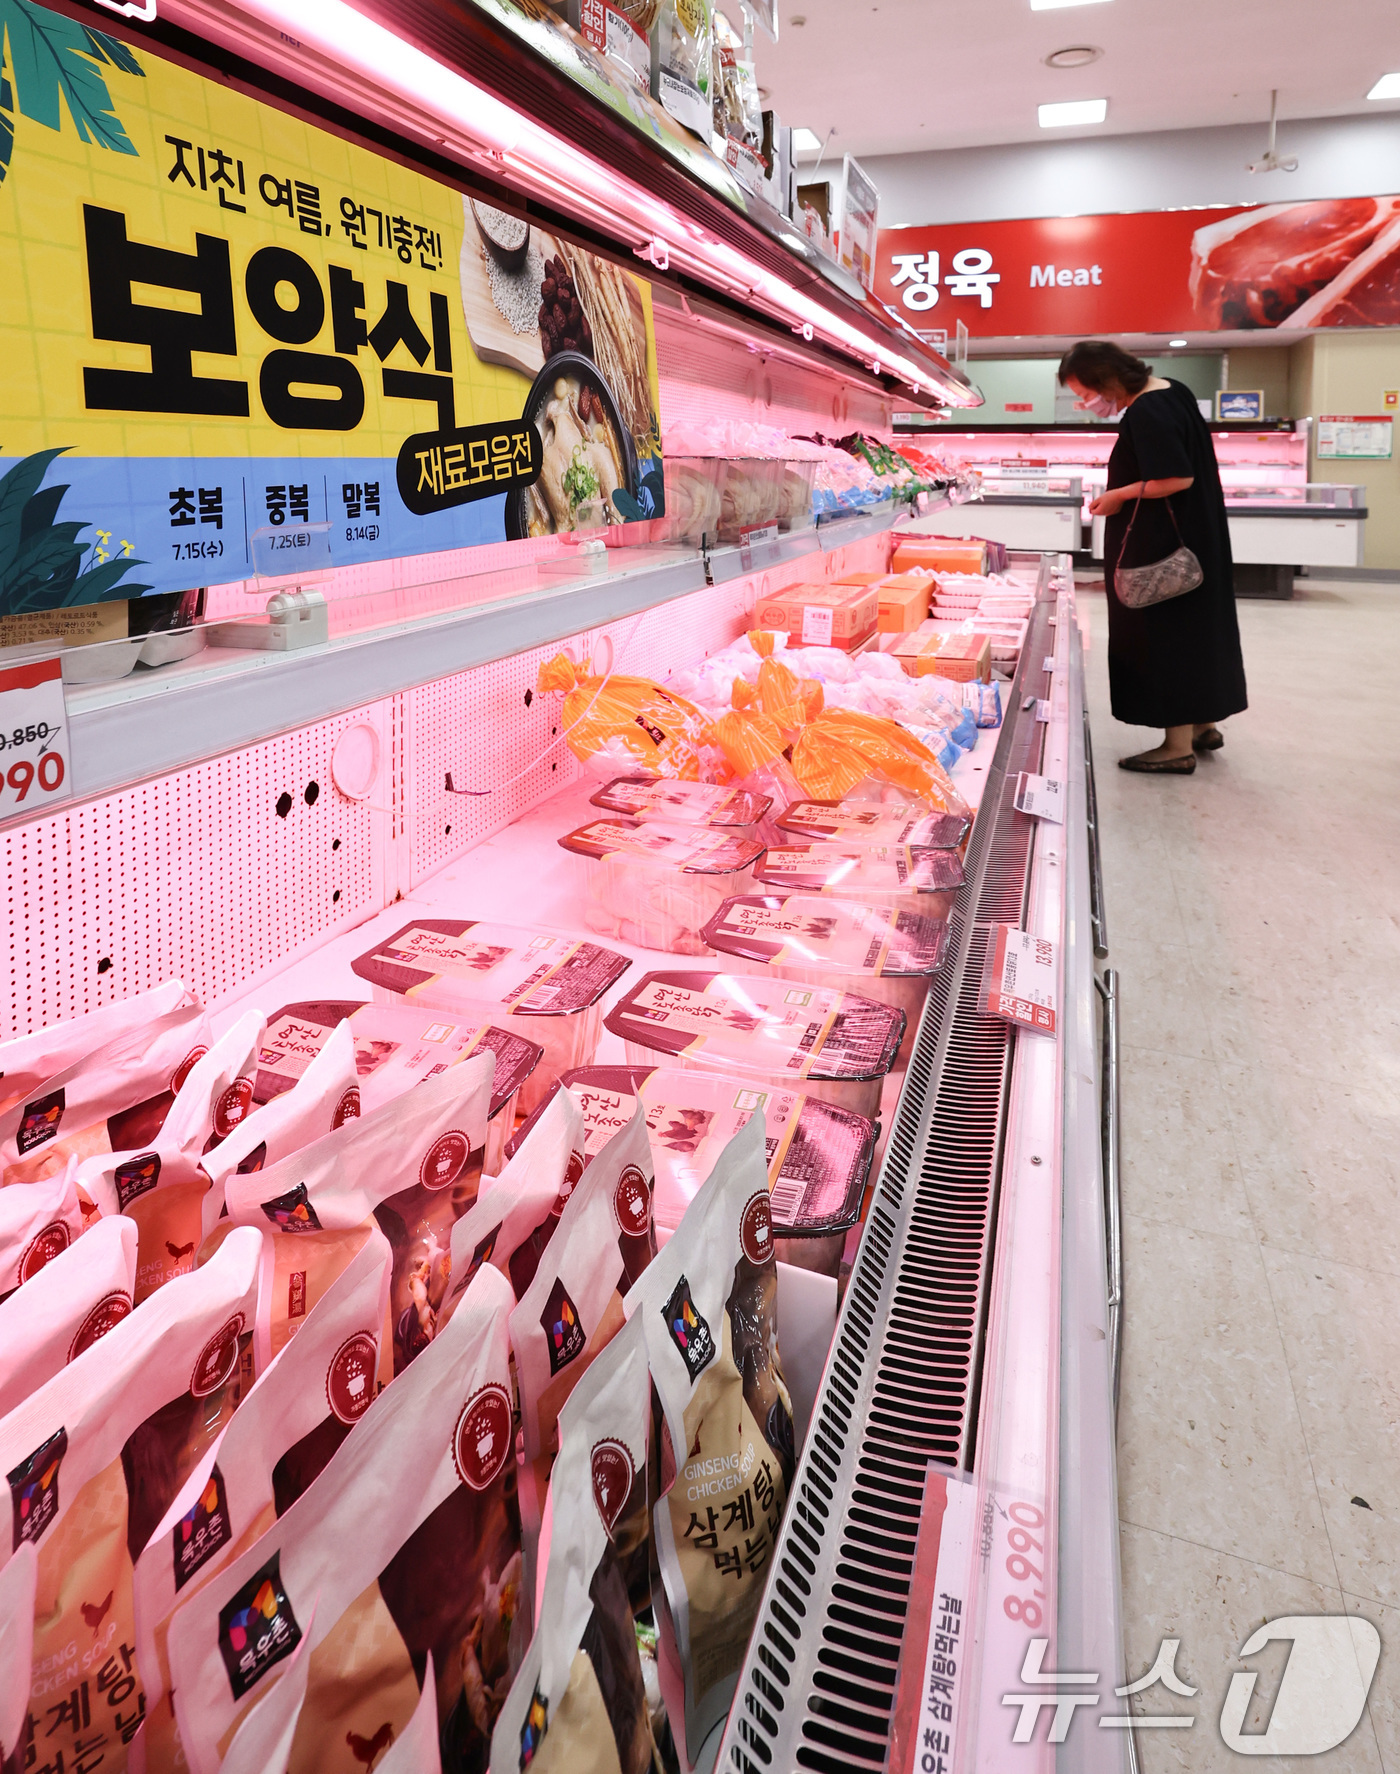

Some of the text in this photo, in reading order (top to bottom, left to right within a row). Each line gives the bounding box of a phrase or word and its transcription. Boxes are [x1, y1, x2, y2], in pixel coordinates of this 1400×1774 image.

[583, 10, 604, 33] 할인
[164, 134, 445, 272] 지친 여름, 원기충전!
[890, 247, 1001, 312] 정육
[1029, 262, 1103, 288] Meat
[82, 203, 456, 431] 보양식
[414, 431, 534, 495] 재료모음전
[168, 486, 224, 529] 초복
[264, 484, 310, 525] 중복
[342, 481, 381, 518] 말복
[171, 539, 225, 562] 7.15(수)
[267, 531, 311, 551] 7.25(토)
[345, 524, 380, 543] 8.14(금)
[0, 751, 65, 803] 90
[1035, 938, 1053, 968] 13,980
[998, 995, 1016, 1016] 가격
[1015, 1000, 1033, 1022] 할인
[1037, 1009, 1050, 1026] 행사
[557, 1324, 580, 1361] 목우촌
[687, 1326, 710, 1364] 목우촌
[684, 1453, 740, 1481] GINSENG
[687, 1442, 756, 1502] CHICKEN SOUP
[684, 1459, 775, 1549] 삼계탕
[181, 1513, 224, 1563] 목우촌
[1003, 1501, 1046, 1630] 8,990
[82, 1621, 117, 1671] SOUP
[240, 1613, 290, 1674] 목우촌
[928, 1593, 963, 1723] 삼계탕먹는날
